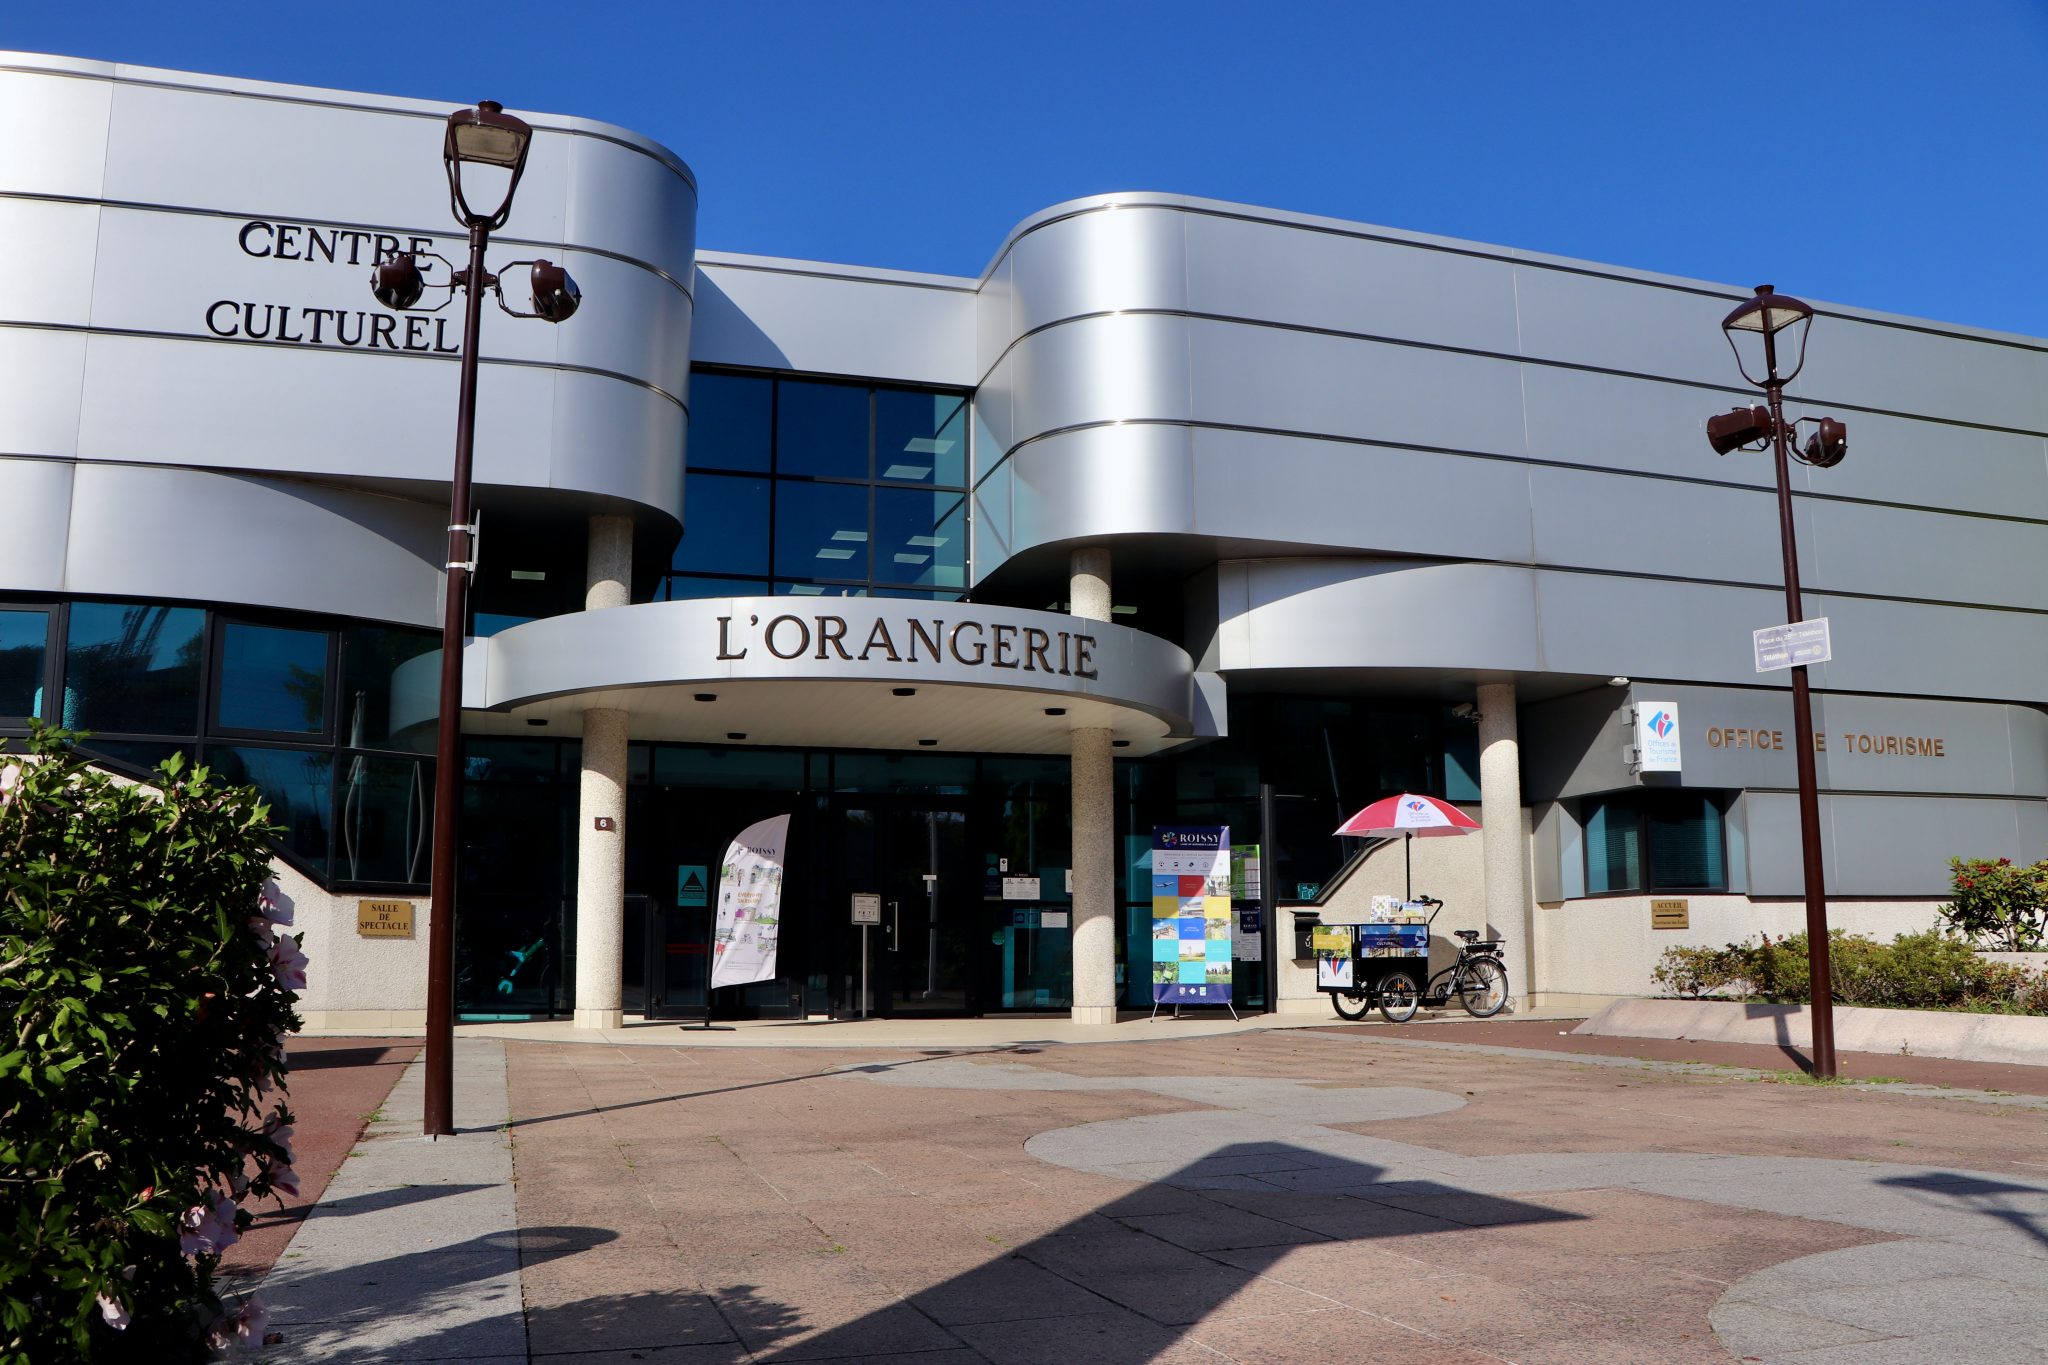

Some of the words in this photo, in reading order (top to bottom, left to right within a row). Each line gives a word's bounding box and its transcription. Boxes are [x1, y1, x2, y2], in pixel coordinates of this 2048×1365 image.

[238, 221, 433, 272] CENTRE
[205, 300, 460, 353] CULTUREL
[716, 614, 1099, 681] L'ORANGERIE
[1706, 727, 1784, 750] OFFICE
[1844, 733, 1945, 757] TOURISME
[600, 819, 607, 828] 6
[1180, 833, 1219, 843] ROISSY
[371, 904, 399, 912] SALLE
[360, 921, 409, 930] SPECTACLE
